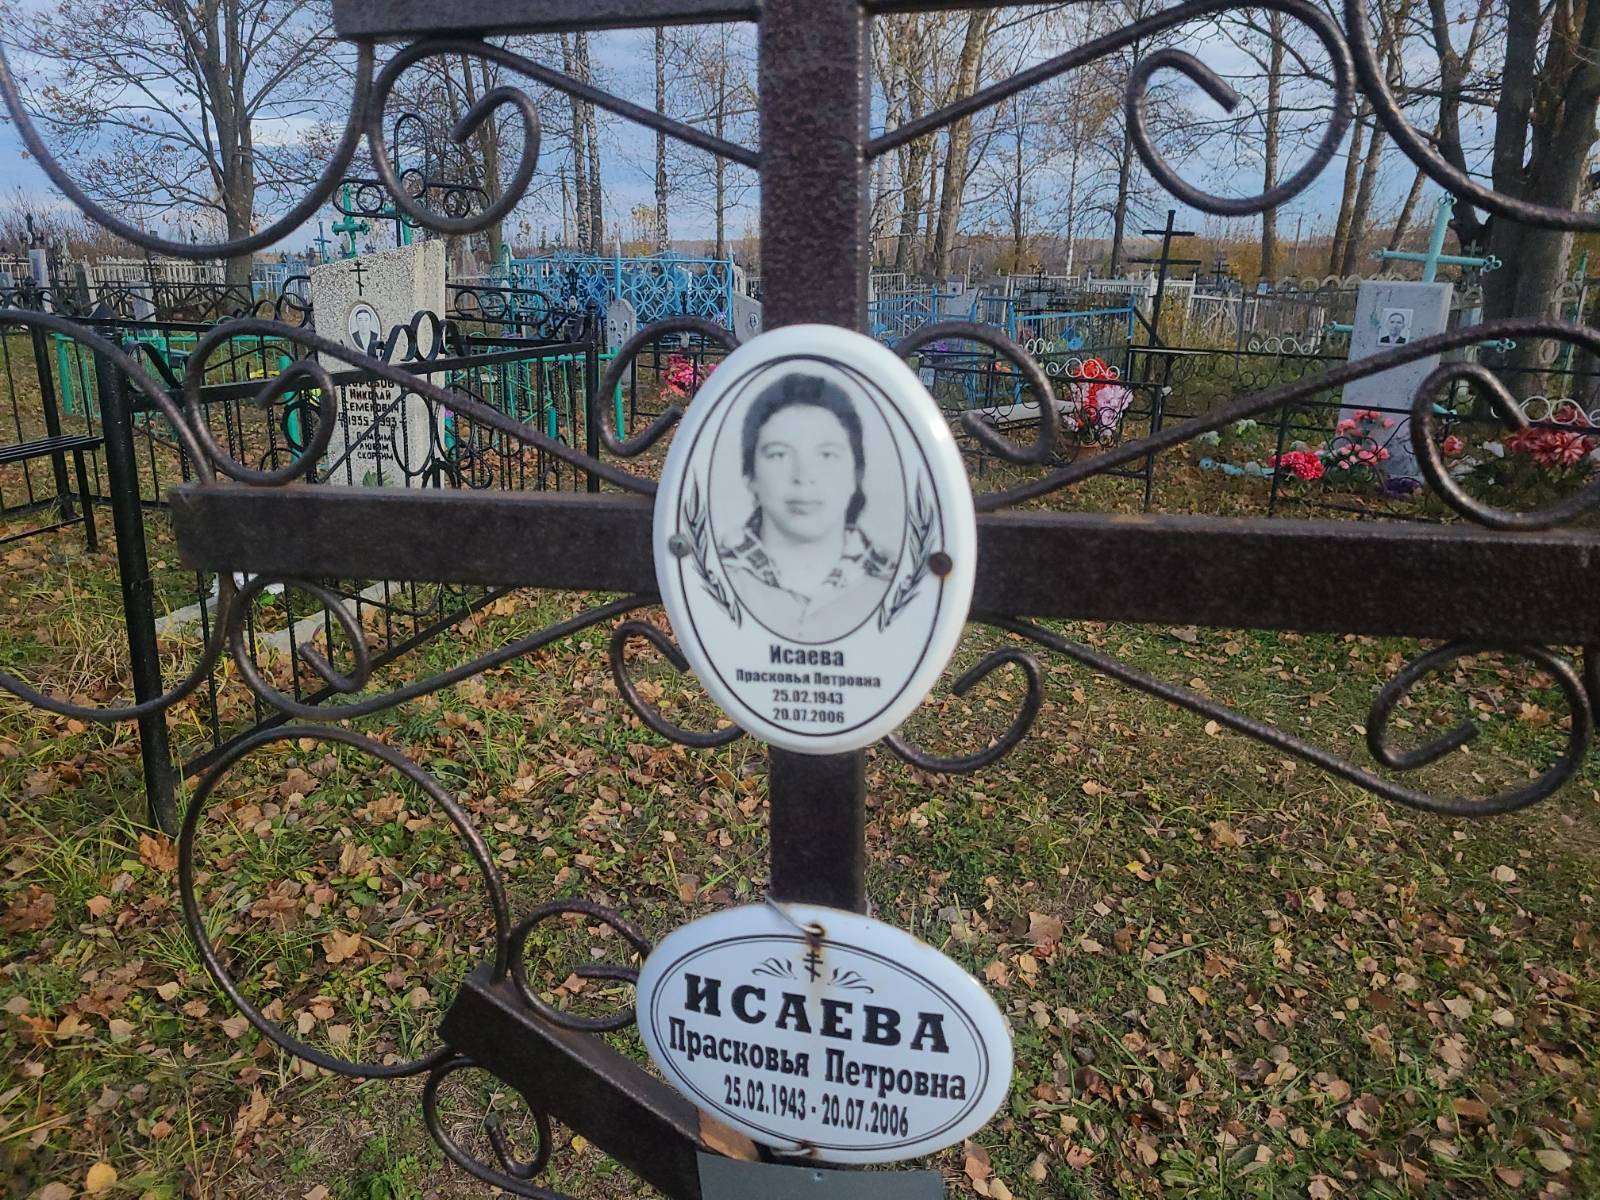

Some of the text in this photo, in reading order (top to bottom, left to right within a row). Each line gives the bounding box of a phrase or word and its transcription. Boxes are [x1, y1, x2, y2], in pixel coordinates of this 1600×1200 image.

[770, 644, 844, 667] Исаева
[736, 669, 881, 688] Прасковья Петровна
[772, 689, 844, 705] 25.02.1943
[773, 708, 845, 723] 20.07.2006
[684, 973, 950, 1053] ИСАЕВА
[668, 1016, 967, 1100] Прасковья Петровна
[724, 1074, 806, 1121] 25.02.1943
[822, 1092, 909, 1137] 20.07.2006
